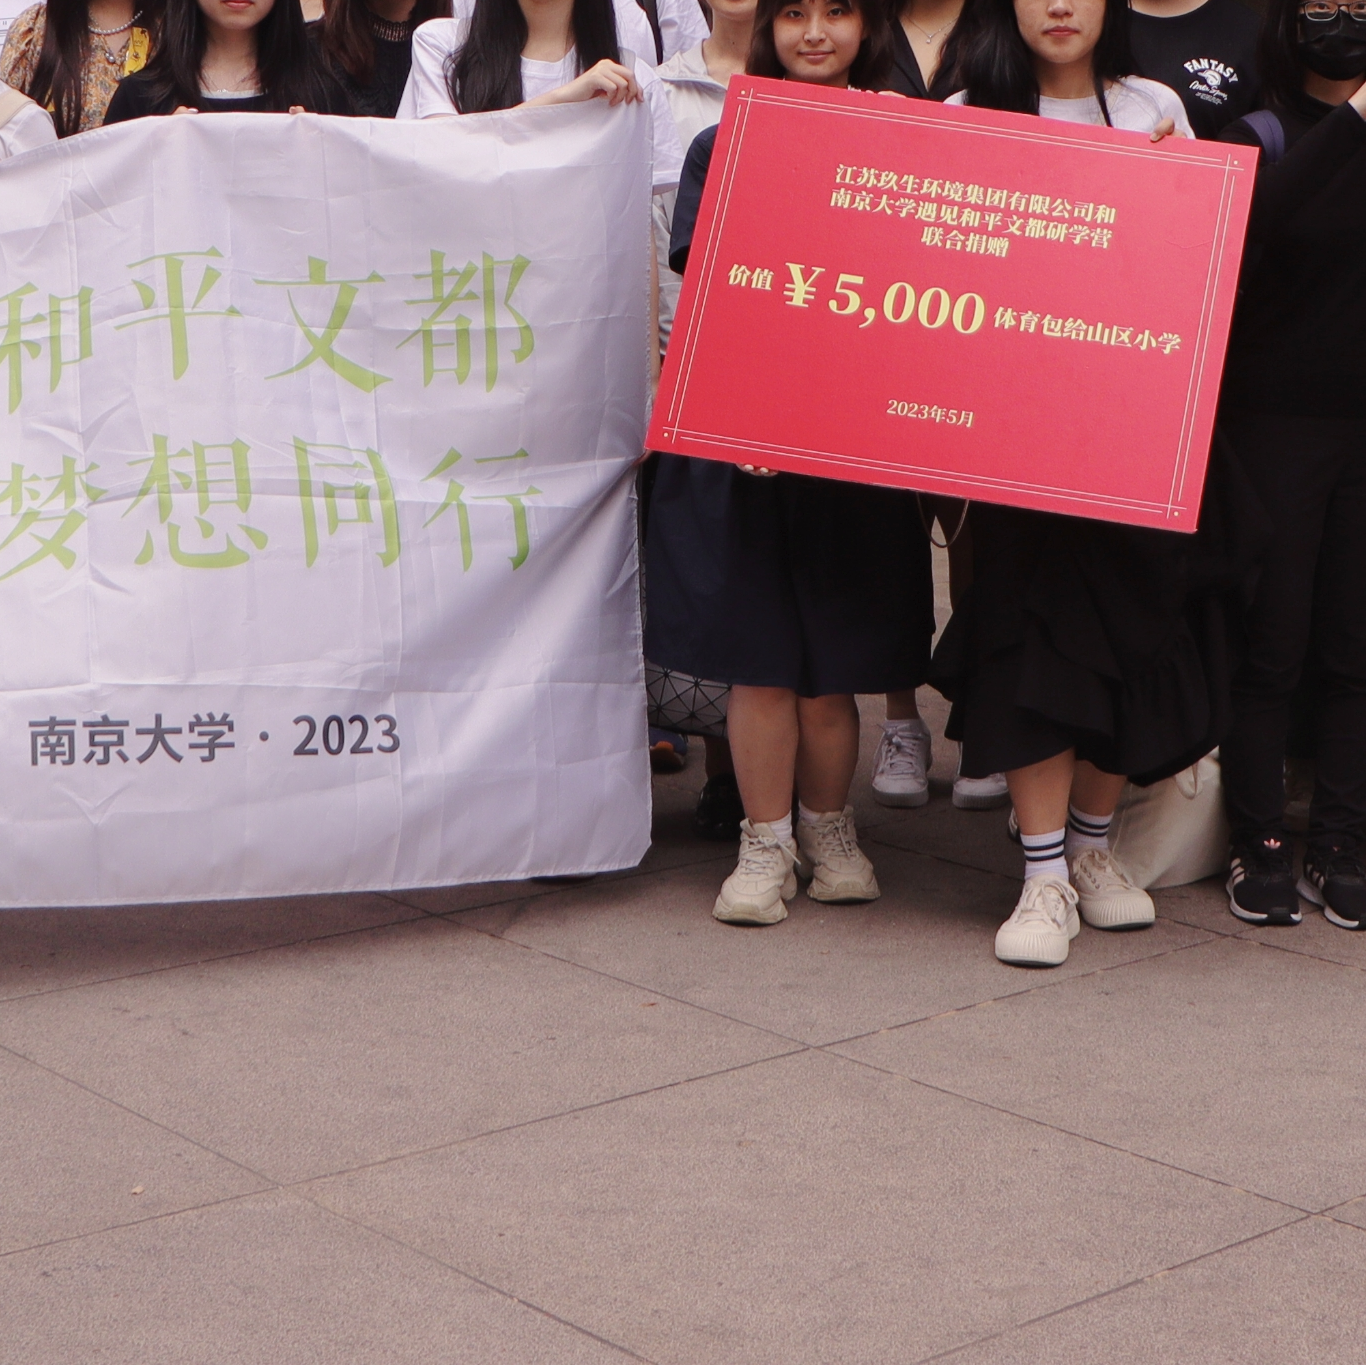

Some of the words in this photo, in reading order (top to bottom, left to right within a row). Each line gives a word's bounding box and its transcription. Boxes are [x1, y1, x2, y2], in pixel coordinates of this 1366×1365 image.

[1183, 57, 1239, 84] FANTASY
[829, 187, 1114, 250] 南京大学遇见和平文都研学营
[834, 163, 1117, 225] 江苏玖生环境集团有限公司和
[920, 225, 1010, 258] 联合捐赠
[727, 264, 775, 292] 价值
[992, 306, 1183, 356] 体育包给山区小学
[886, 399, 975, 429] 2023年5月
[28, 712, 236, 766] 南京大学
[292, 713, 402, 756] 2023
